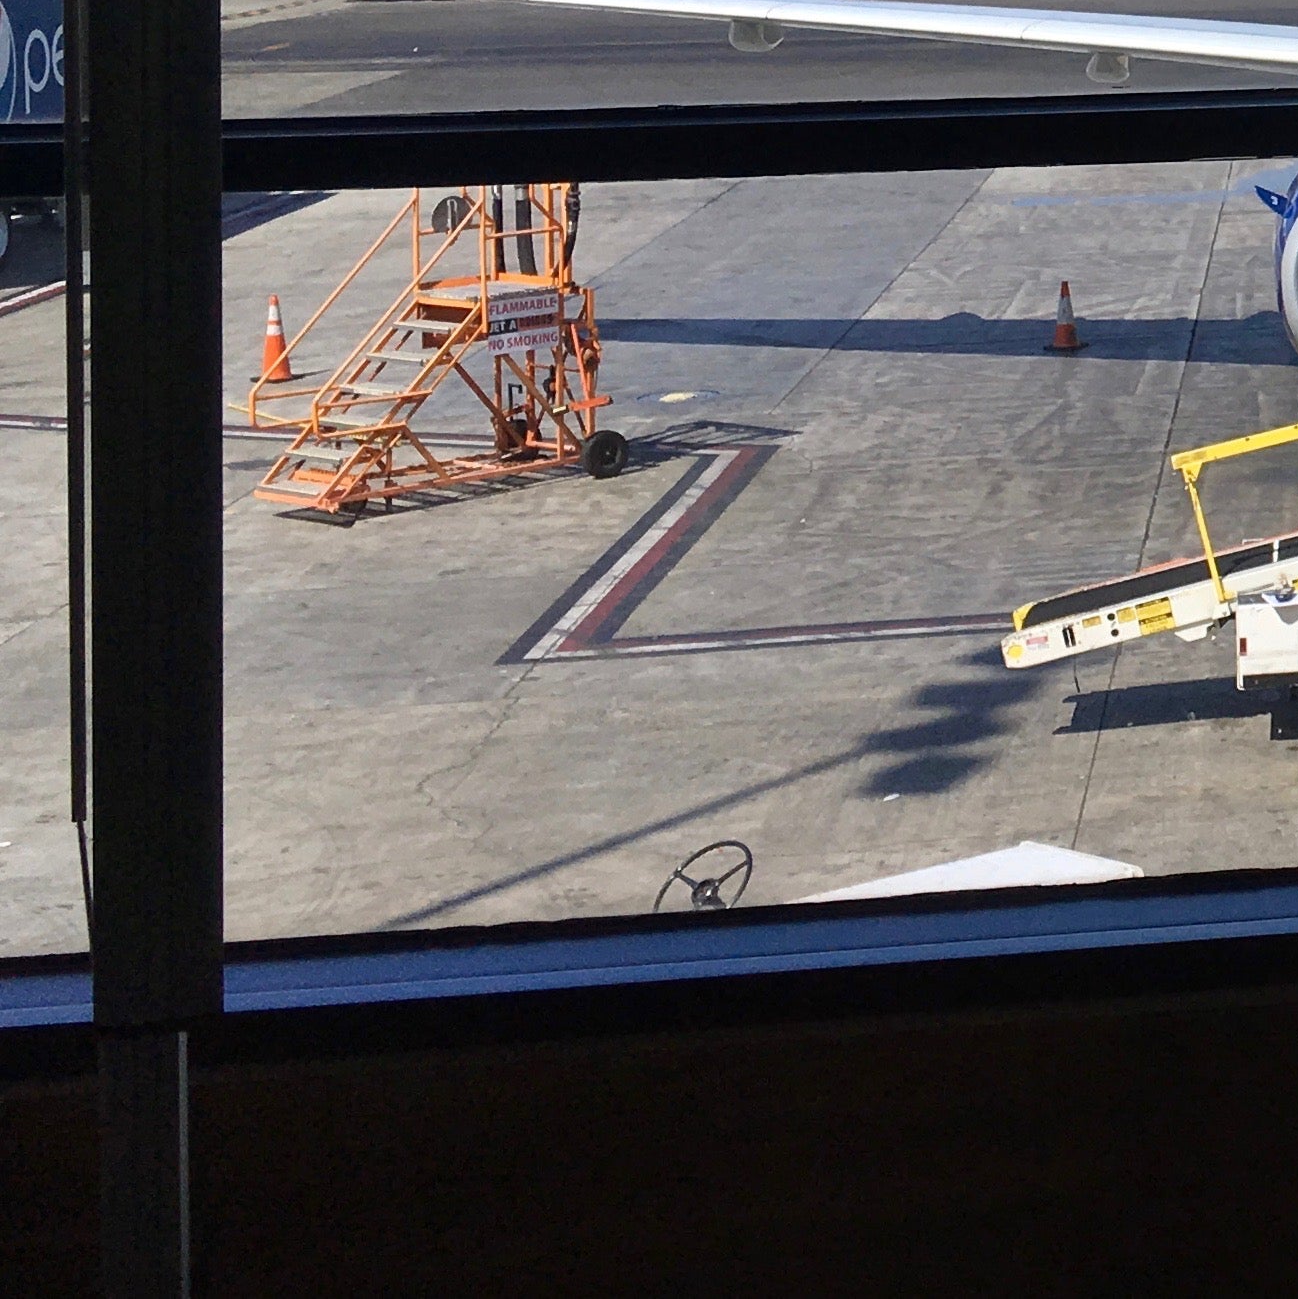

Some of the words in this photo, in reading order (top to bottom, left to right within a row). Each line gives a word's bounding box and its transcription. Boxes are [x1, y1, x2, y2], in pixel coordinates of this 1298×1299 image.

[489, 297, 557, 316] FLAMMABLE
[489, 321, 506, 334] JET
[509, 319, 518, 330] A
[488, 339, 505, 352] NO
[506, 332, 558, 349] SMOKING
